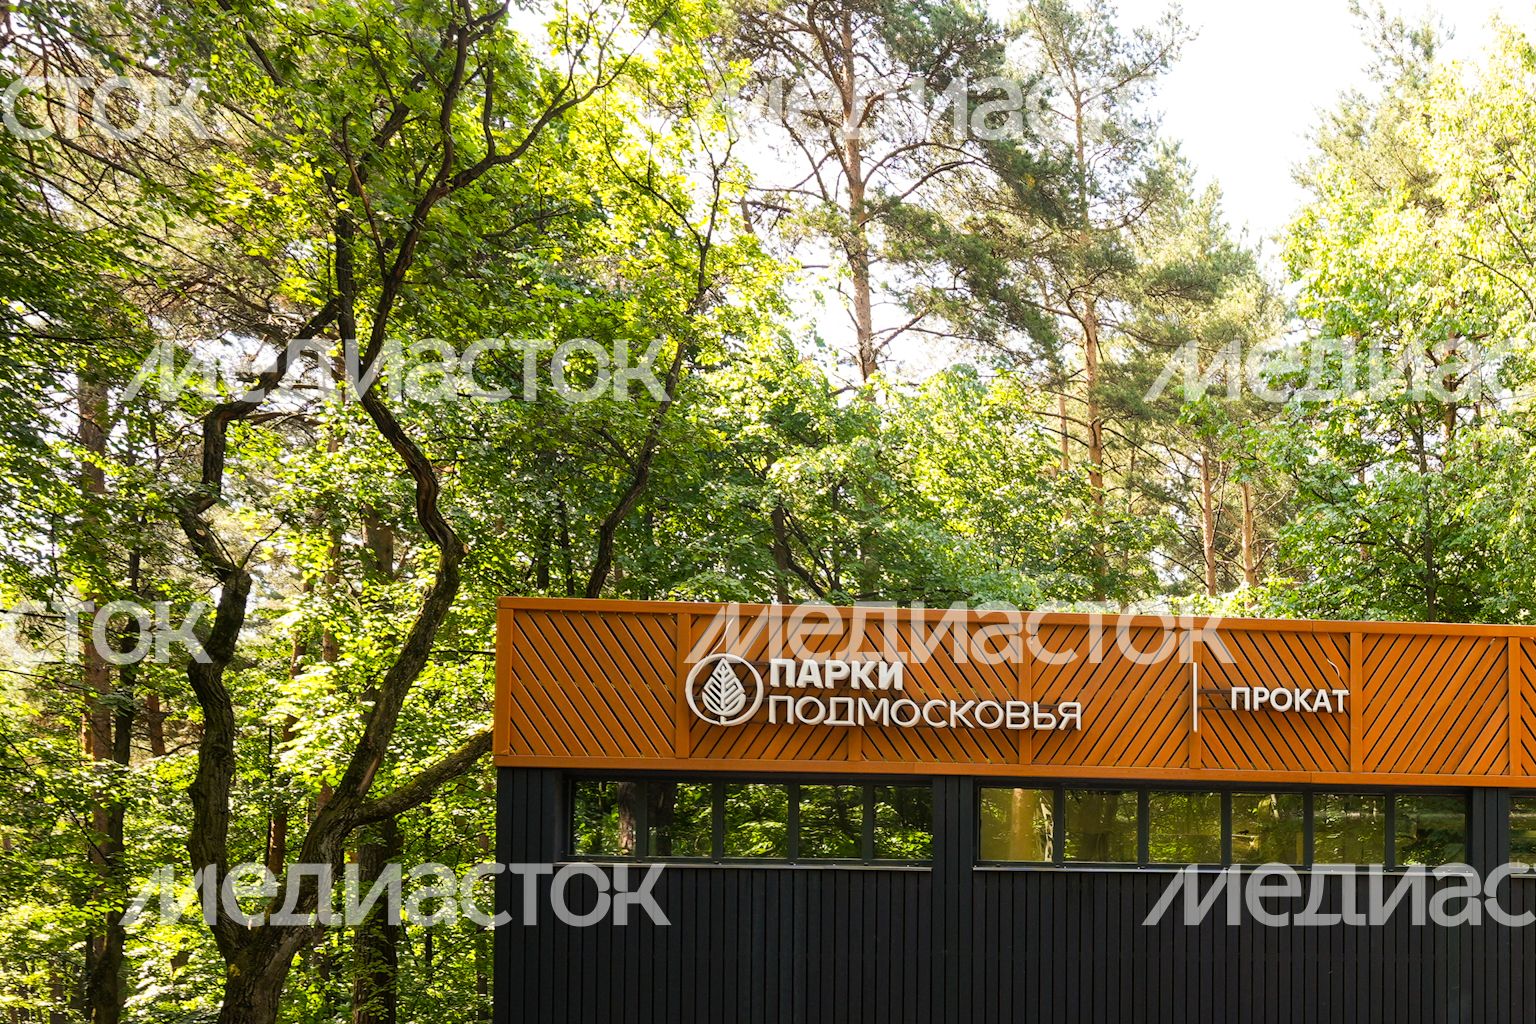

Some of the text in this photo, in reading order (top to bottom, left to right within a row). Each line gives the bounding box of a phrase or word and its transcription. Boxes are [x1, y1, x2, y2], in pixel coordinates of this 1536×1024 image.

[769, 657, 904, 691] ПАРКИ
[767, 693, 1082, 731] ПОДМОСКОВЬЯ
[1230, 685, 1350, 715] ПРОКАТ
